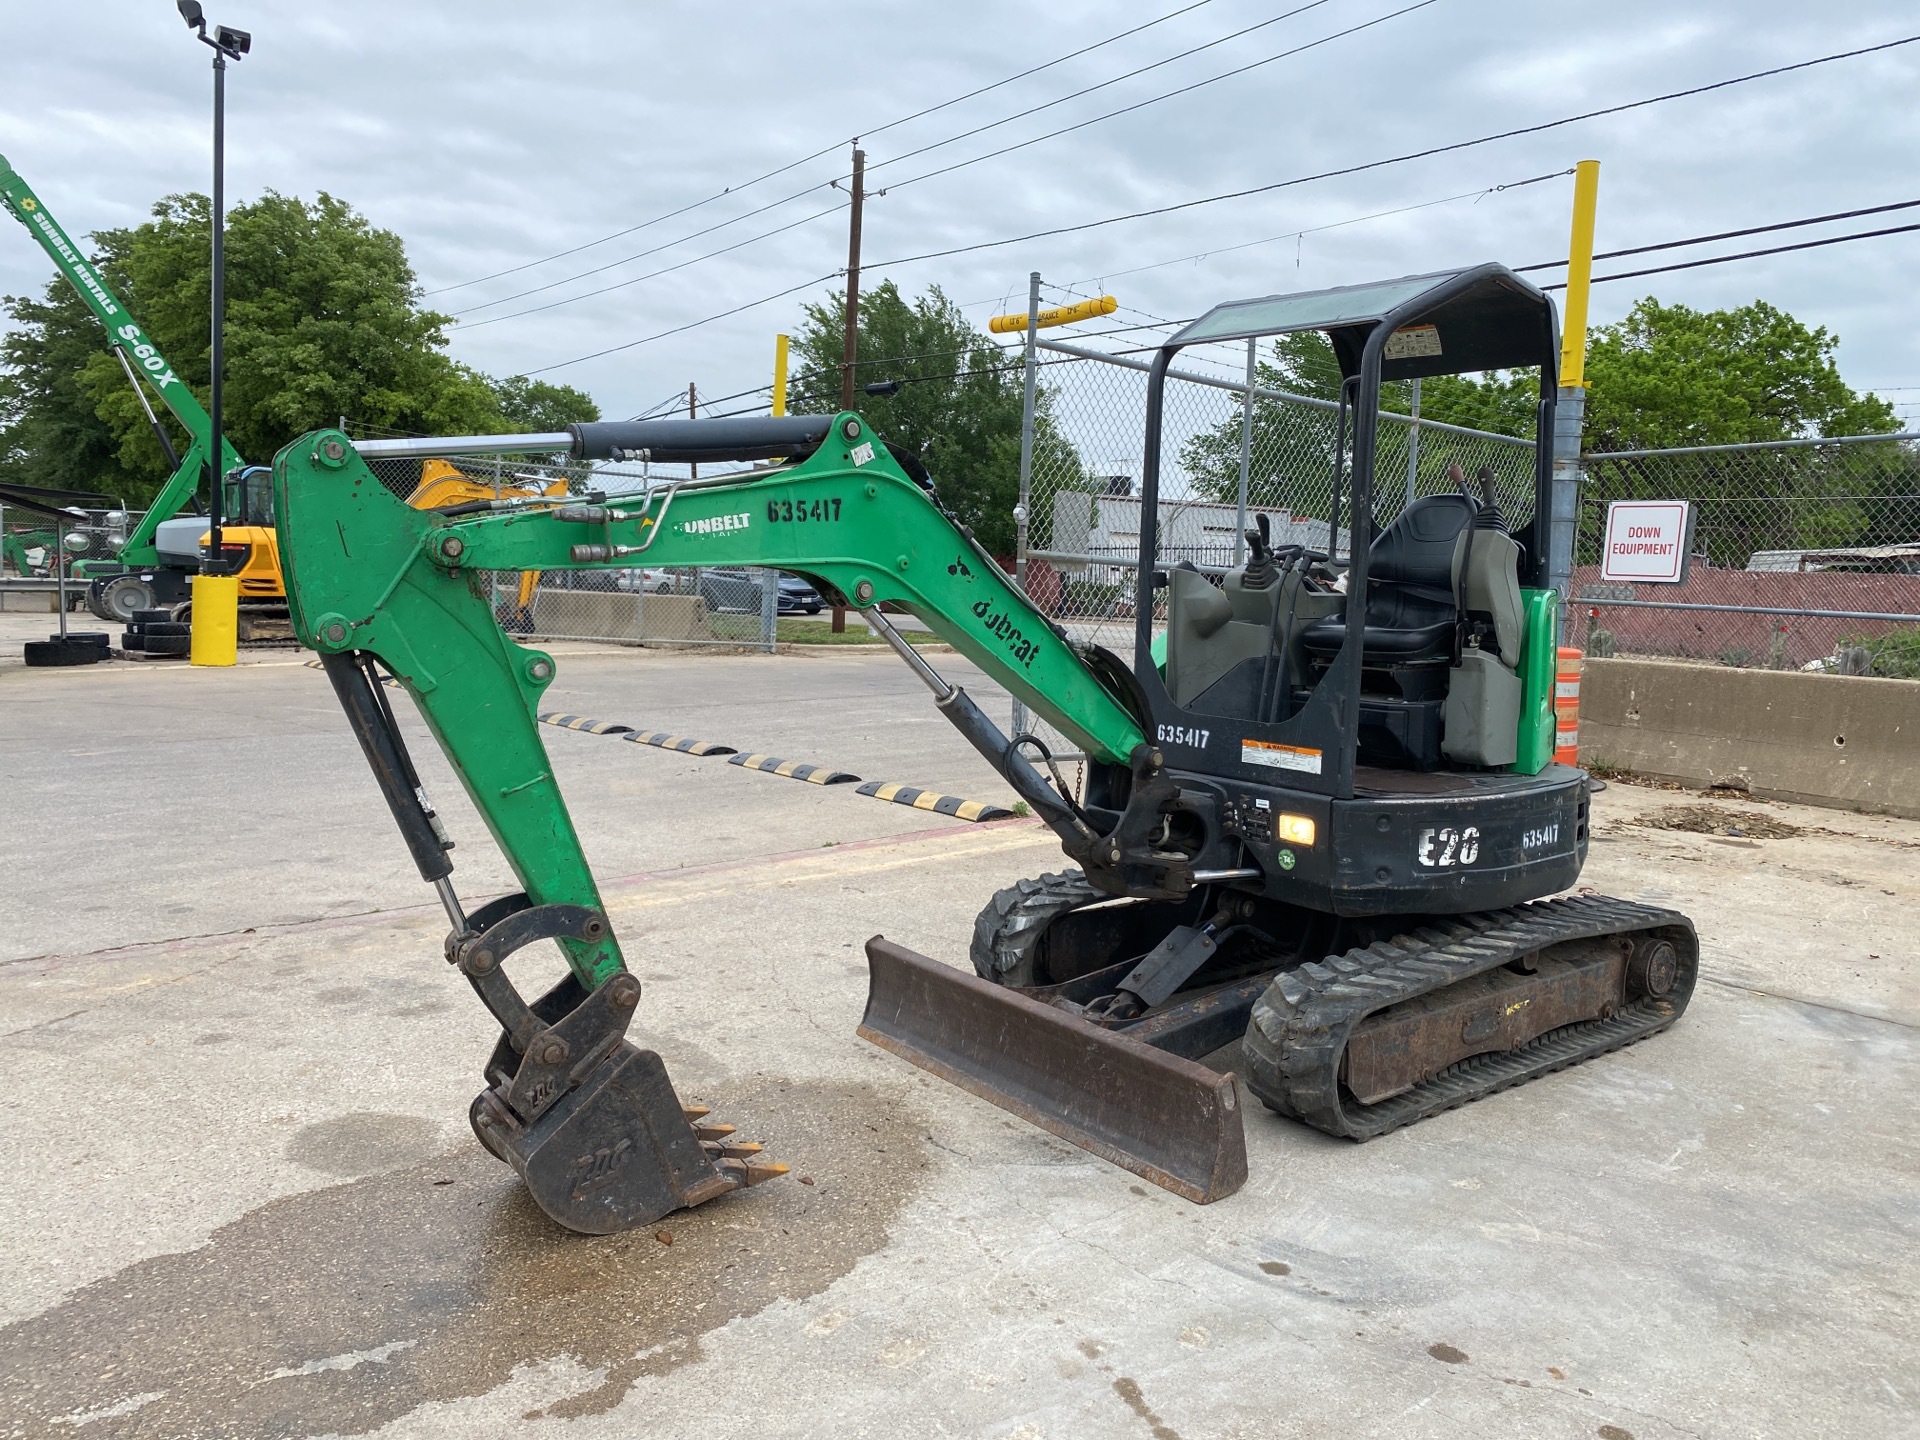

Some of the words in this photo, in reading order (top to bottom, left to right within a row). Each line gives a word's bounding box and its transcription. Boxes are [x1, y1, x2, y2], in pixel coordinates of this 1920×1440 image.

[32, 211, 80, 264] SUNBELT
[72, 263, 118, 315] RENTALS
[117, 324, 180, 389] S-60X
[767, 498, 842, 523] 635417
[671, 512, 751, 538] SUNBELT
[1627, 526, 1661, 538] DOWN
[1612, 543, 1674, 555] EQUIPMENT
[1157, 723, 1210, 749] 635417
[1522, 824, 1559, 849] 635417
